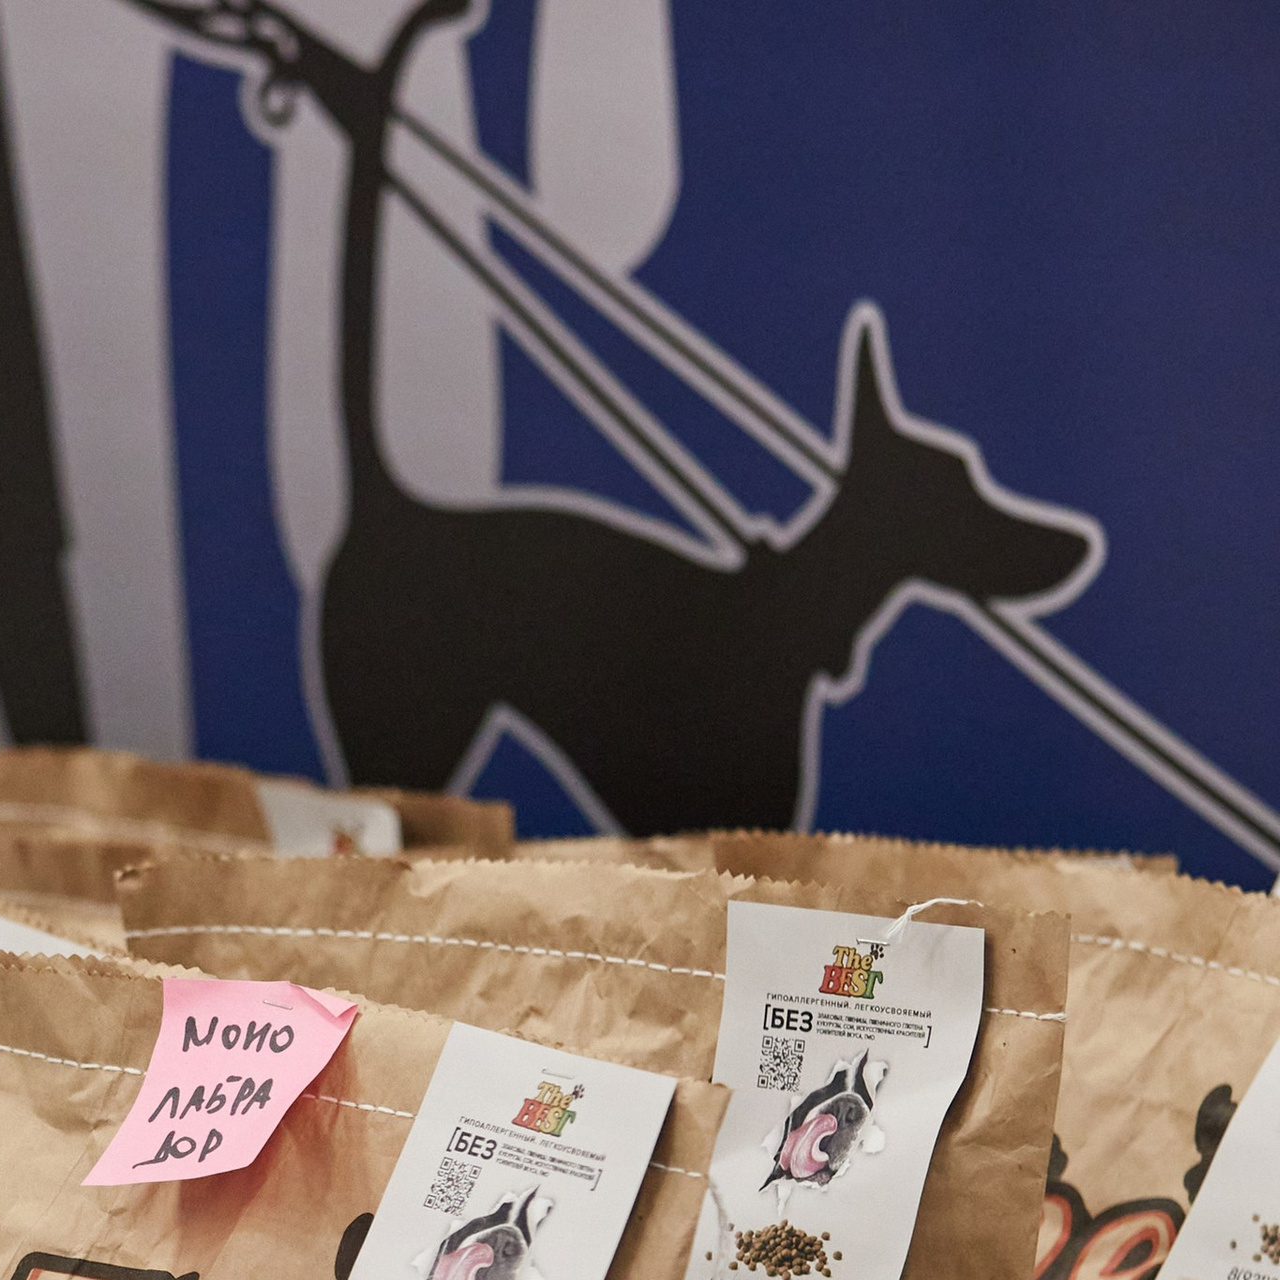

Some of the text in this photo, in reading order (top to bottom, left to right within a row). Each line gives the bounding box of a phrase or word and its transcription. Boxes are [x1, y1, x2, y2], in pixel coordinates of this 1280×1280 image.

[833, 945, 874, 971] The
[819, 965, 883, 999] BEST
[854, 1003, 932, 1019] ЛЕГКОУСВОЯЕМЫЙ
[182, 1016, 294, 1053] МОНО
[148, 1075, 273, 1123] ЛАБРА
[537, 1081, 574, 1110] The
[512, 1098, 577, 1137] BEST
